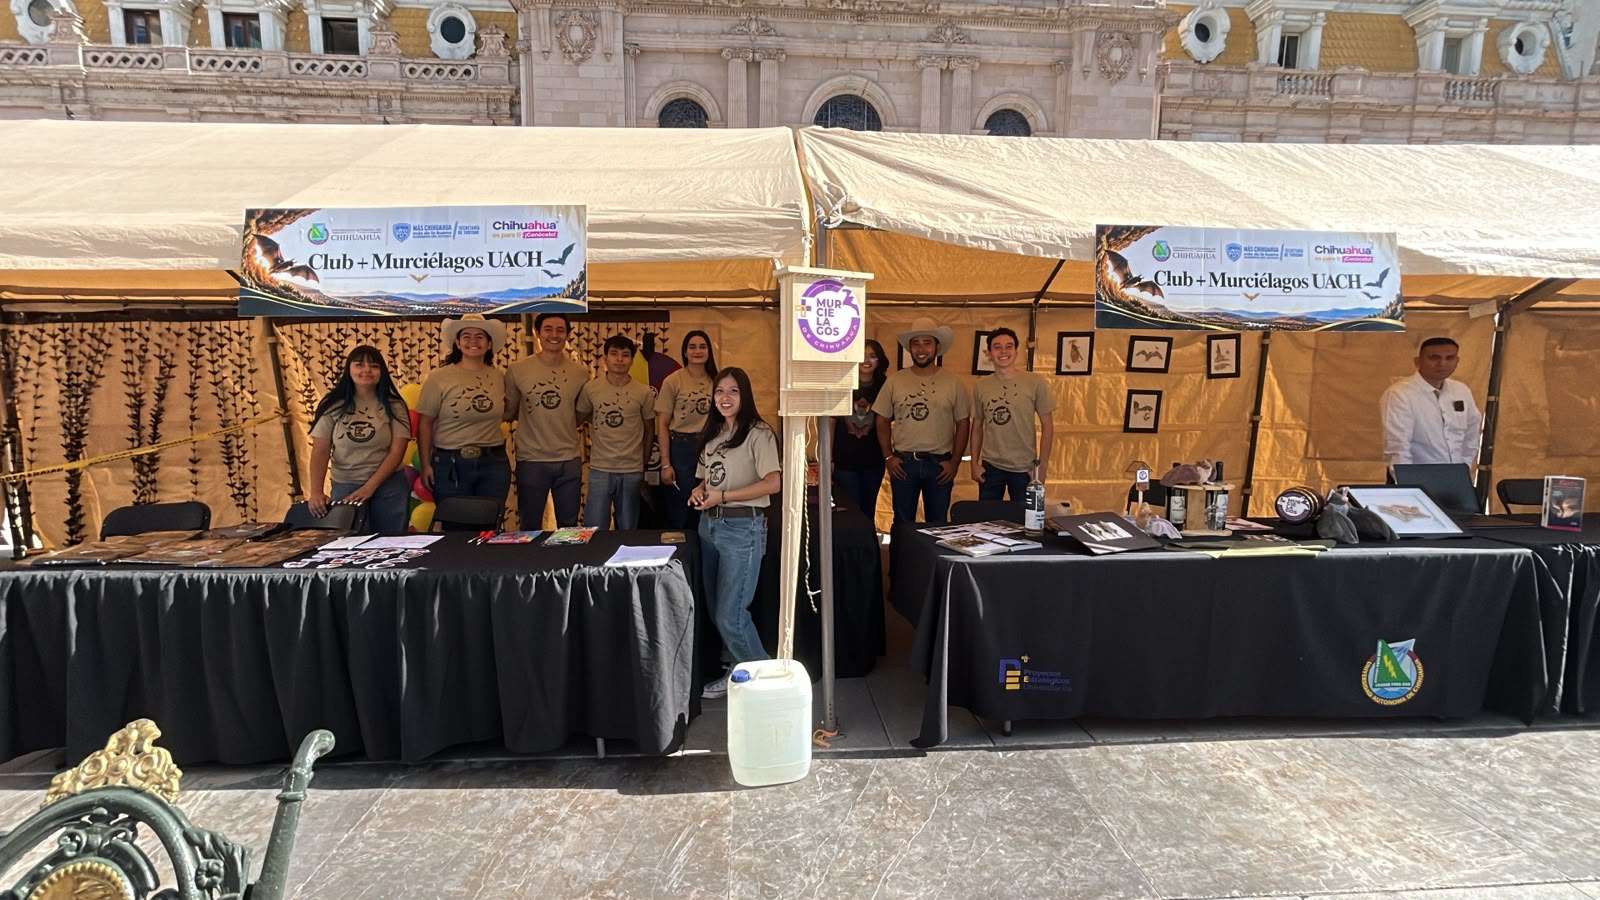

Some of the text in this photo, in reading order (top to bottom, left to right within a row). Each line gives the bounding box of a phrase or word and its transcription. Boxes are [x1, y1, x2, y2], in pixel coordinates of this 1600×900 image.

[492, 220, 556, 230] Chihuahua
[1314, 245, 1371, 254] Chihuahua
[308, 250, 543, 273] Club + Murciélagos UACH
[1154, 270, 1362, 293] Club + Murciélagos UACH
[816, 299, 841, 308] MUR
[816, 308, 834, 317] CIE
[816, 318, 830, 326] LA
[816, 327, 840, 336] GOS
